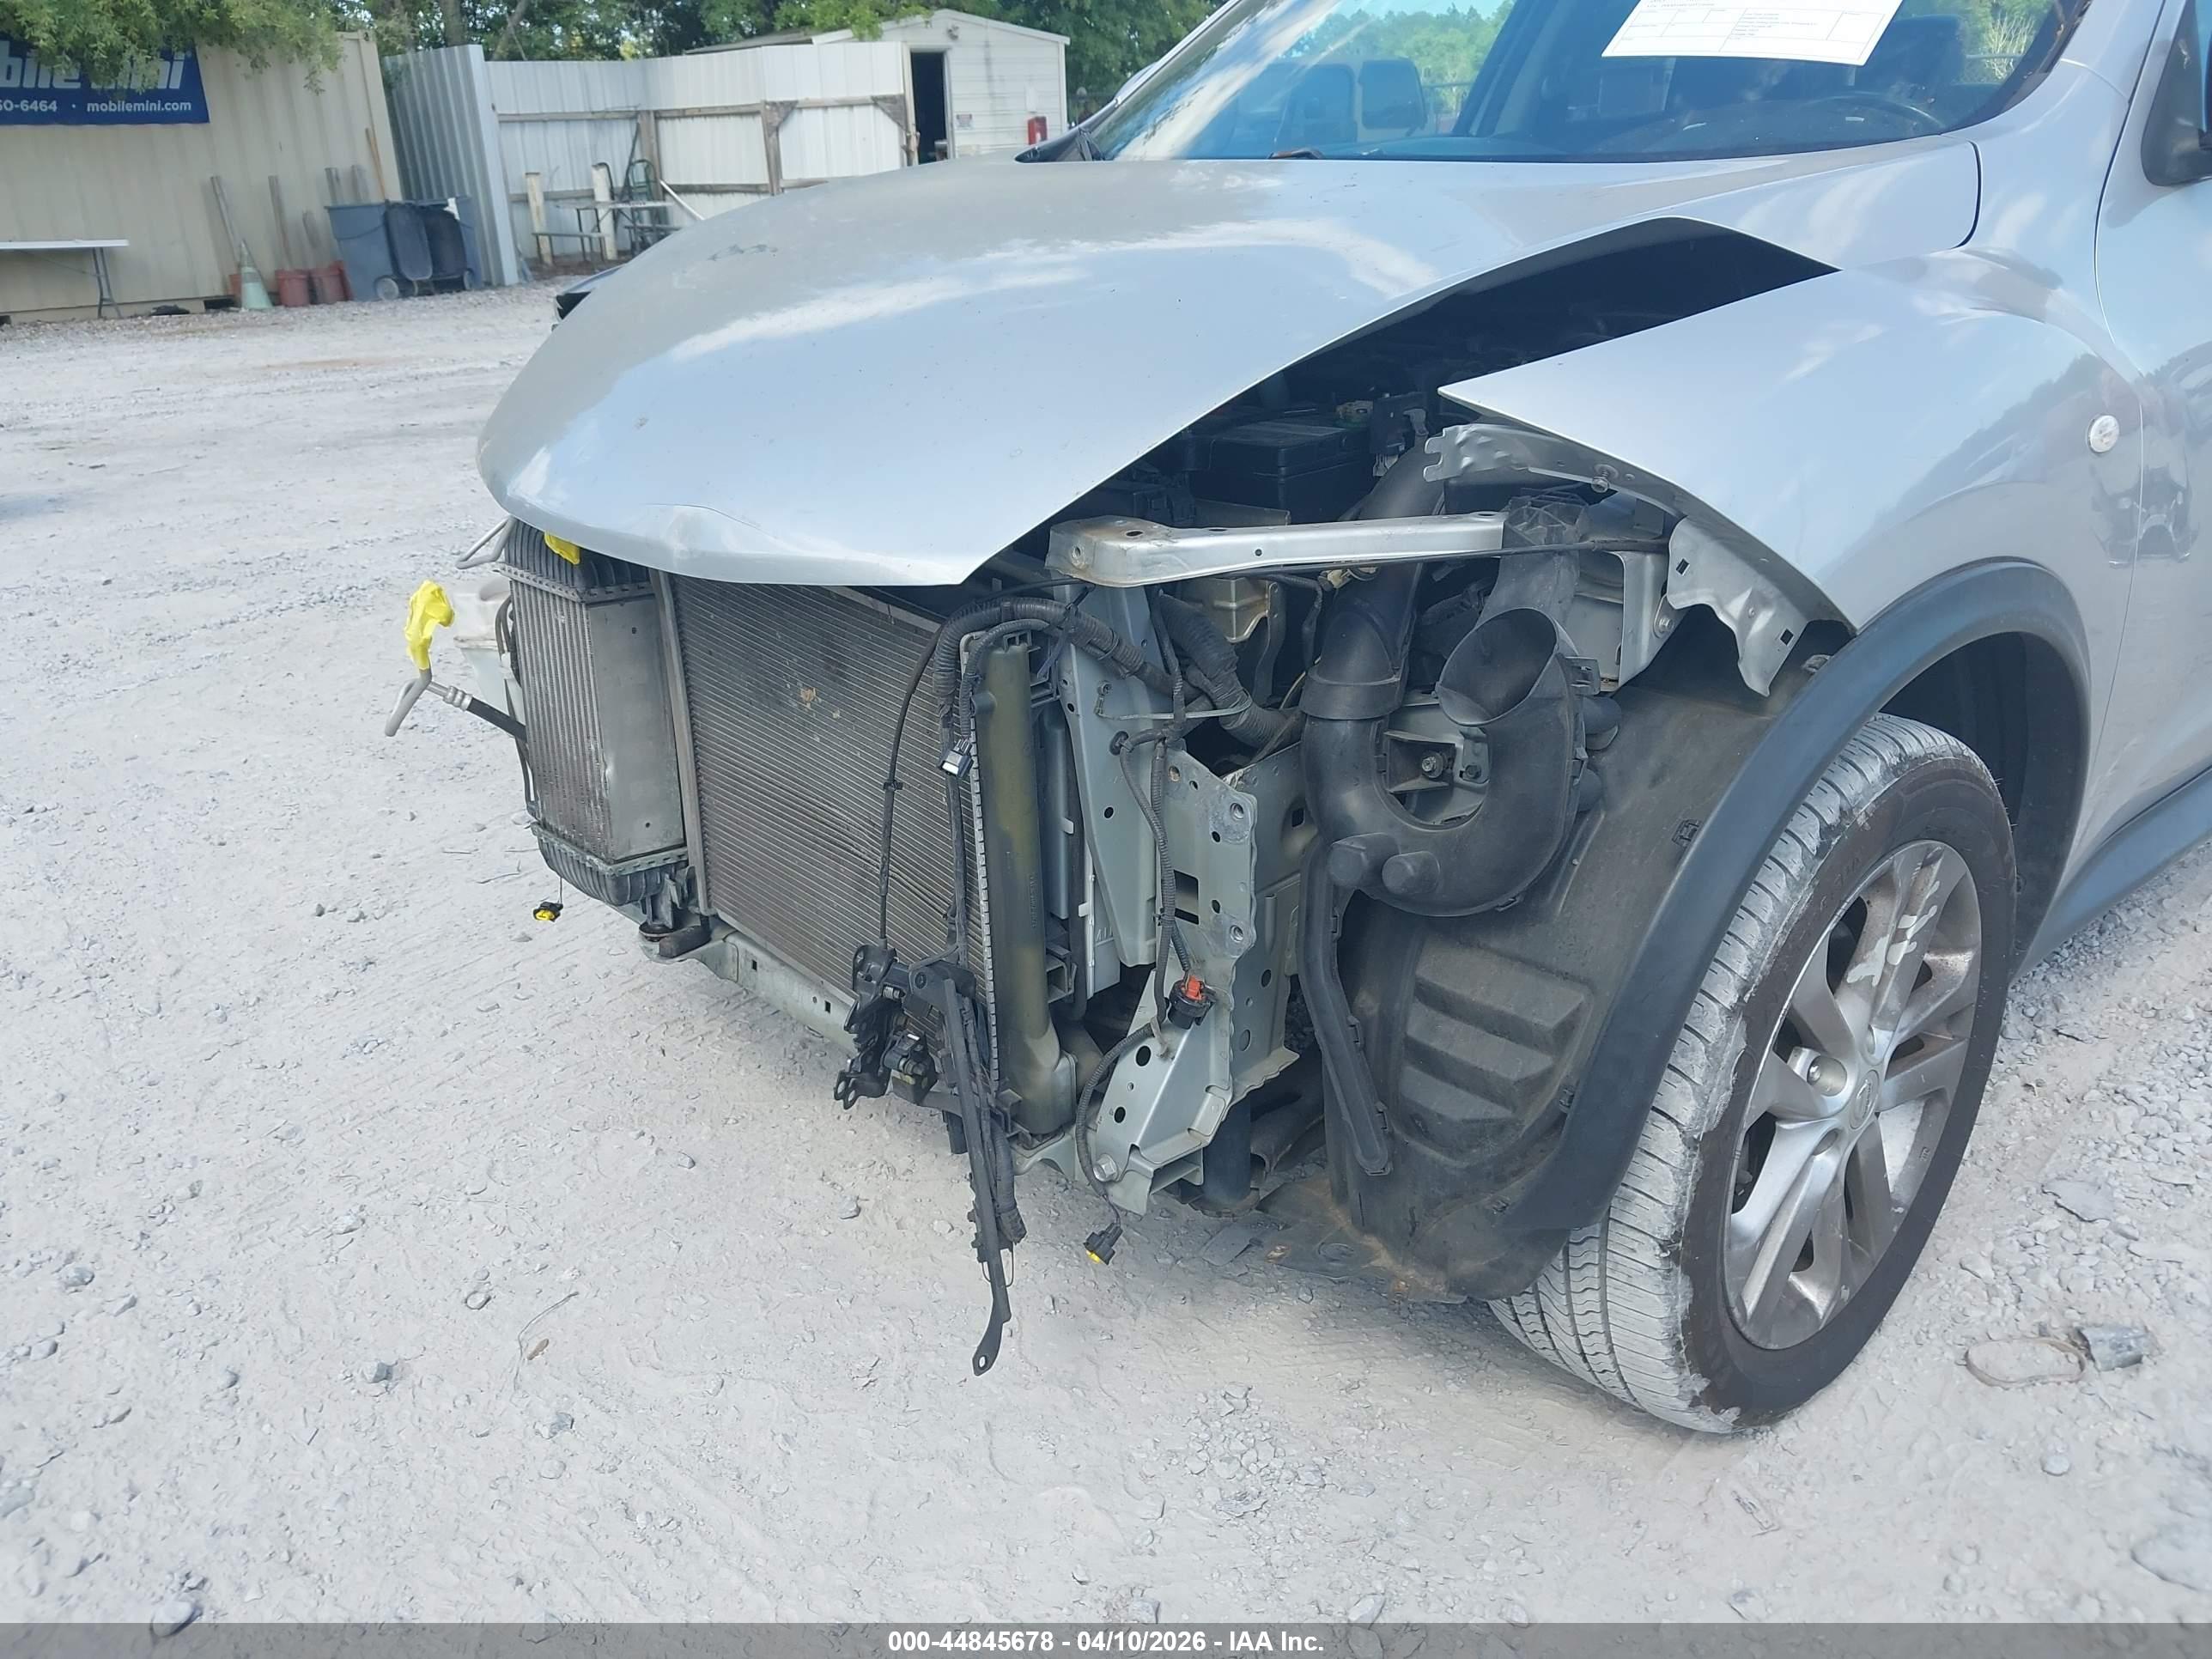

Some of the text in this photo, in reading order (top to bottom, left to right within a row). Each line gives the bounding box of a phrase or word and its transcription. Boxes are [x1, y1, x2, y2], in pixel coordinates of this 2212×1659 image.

[90, 51, 185, 89] ini
[0, 100, 191, 112] 0-6464 mobilemini.com
